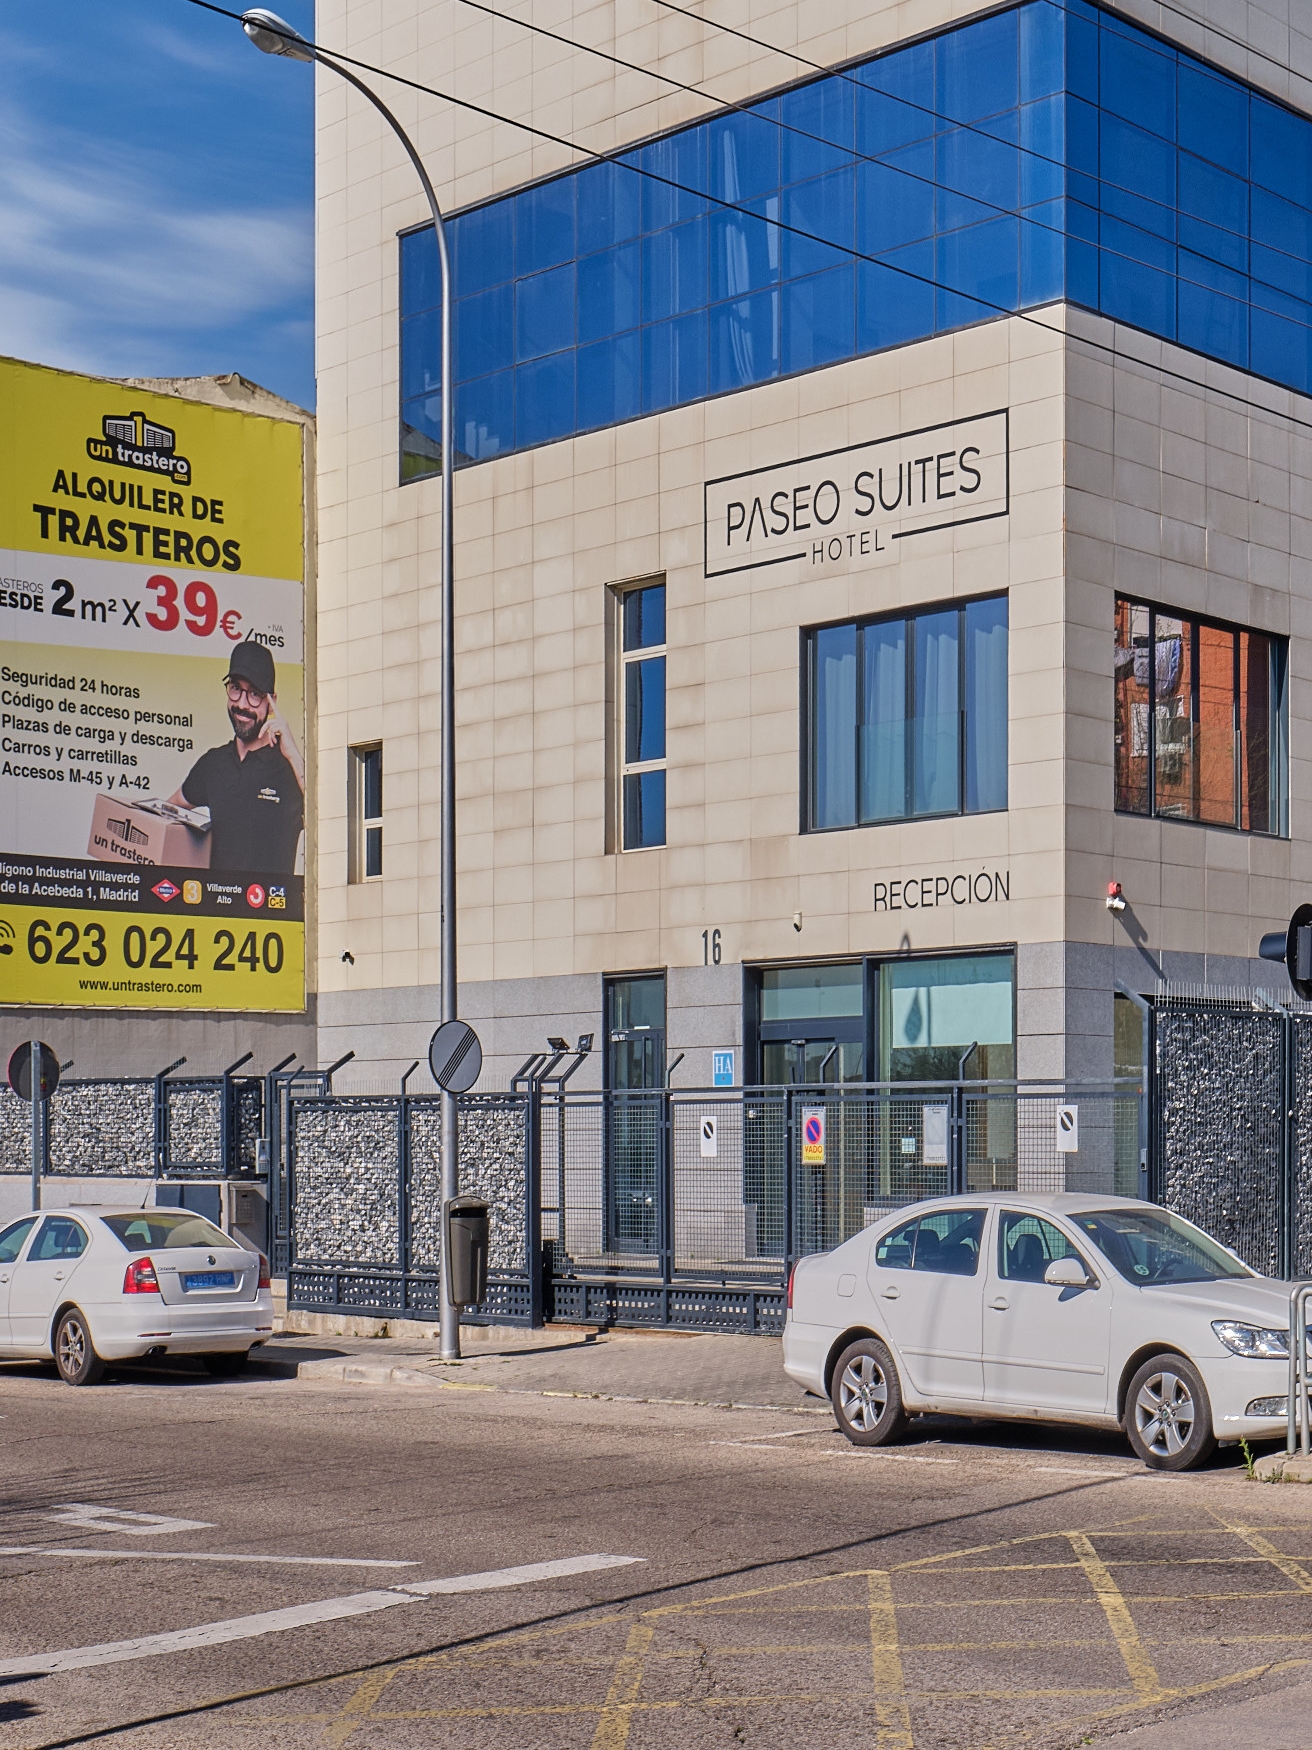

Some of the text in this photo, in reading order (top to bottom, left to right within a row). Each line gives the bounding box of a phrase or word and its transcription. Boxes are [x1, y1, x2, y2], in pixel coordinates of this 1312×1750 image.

[90, 442, 188, 474] un trastero
[52, 469, 225, 524] ALQUILER DE
[726, 446, 982, 547] PASEO SUITES
[32, 503, 242, 572] TRASTEROS
[812, 528, 885, 565] HOTEL
[51, 579, 76, 618] 2
[1, 666, 140, 699] Seguridad 24 horas
[1, 690, 193, 728] Código de acceso personal
[2, 713, 194, 753] Plazas de carga y descarga
[2, 737, 138, 767] Carros y carretillas
[2, 761, 151, 790] Accesos M-45 y A-42
[94, 834, 108, 849] un
[36, 865, 86, 880] Industrial
[89, 869, 140, 884] Villaverde
[207, 883, 242, 894] Villaverde
[874, 866, 1011, 912] RECEPCIÓN
[0, 880, 139, 901] de la Acebeda 1, Madrid
[187, 882, 197, 902] 3
[217, 895, 232, 904] Alto
[269, 887, 285, 897] C-4
[269, 897, 285, 907] C-5
[27, 918, 285, 974] 623 024 240
[701, 928, 722, 966] 16
[79, 977, 202, 994] www.untrastero.com
[715, 1056, 732, 1074] HA
